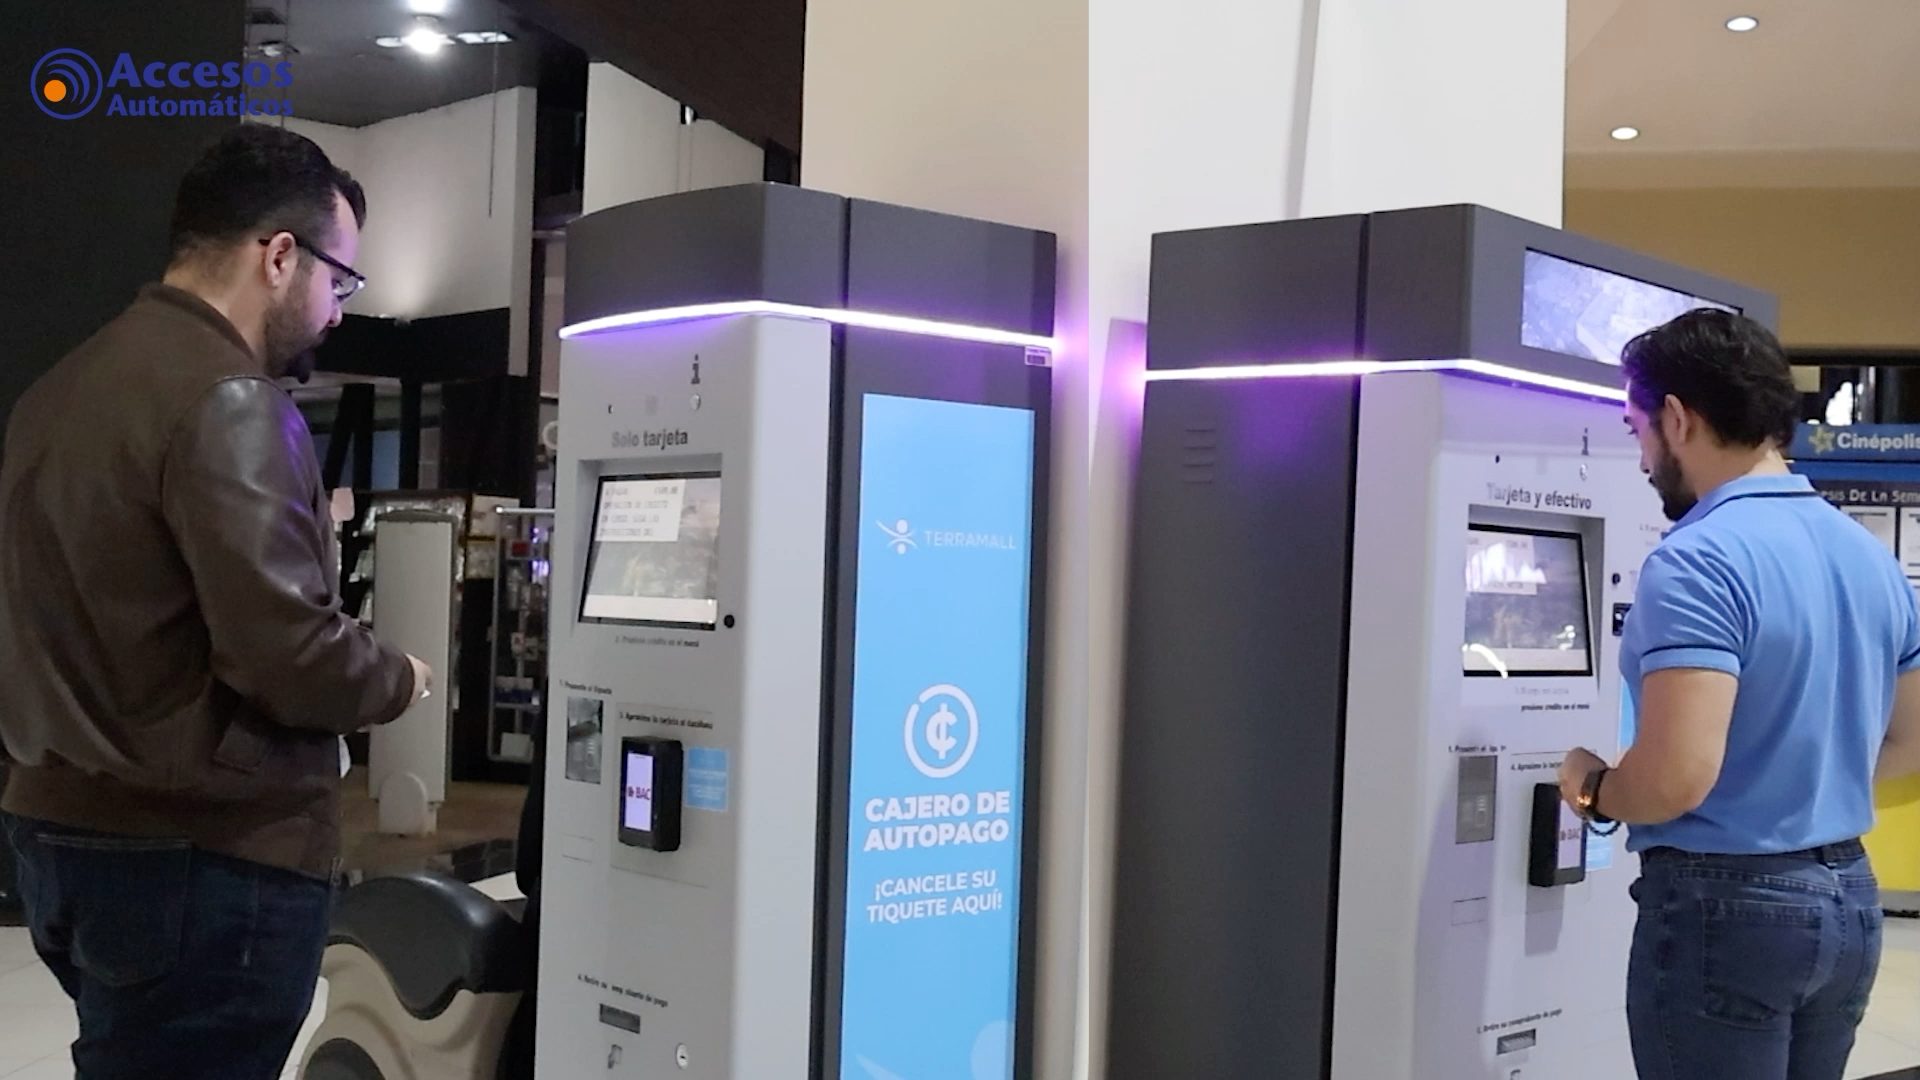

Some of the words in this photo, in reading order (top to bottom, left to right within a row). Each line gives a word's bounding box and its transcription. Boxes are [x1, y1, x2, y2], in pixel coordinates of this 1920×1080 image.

[611, 430, 640, 448] Solo
[643, 428, 688, 450] tarjeta
[1487, 482, 1531, 505] Tarjeta
[1534, 491, 1542, 508] y
[1544, 490, 1592, 509] efectivo
[924, 530, 1017, 550] TERRAMALL
[636, 786, 651, 801] BAC
[865, 793, 970, 822] CAJERO
[976, 791, 1011, 814] DE
[863, 819, 1010, 851] AUTOPAGO
[874, 872, 968, 901] ¡CANCELE
[972, 870, 996, 889] SU
[866, 899, 947, 924] TIQUETE
[951, 889, 1003, 915] AQUÍ!
